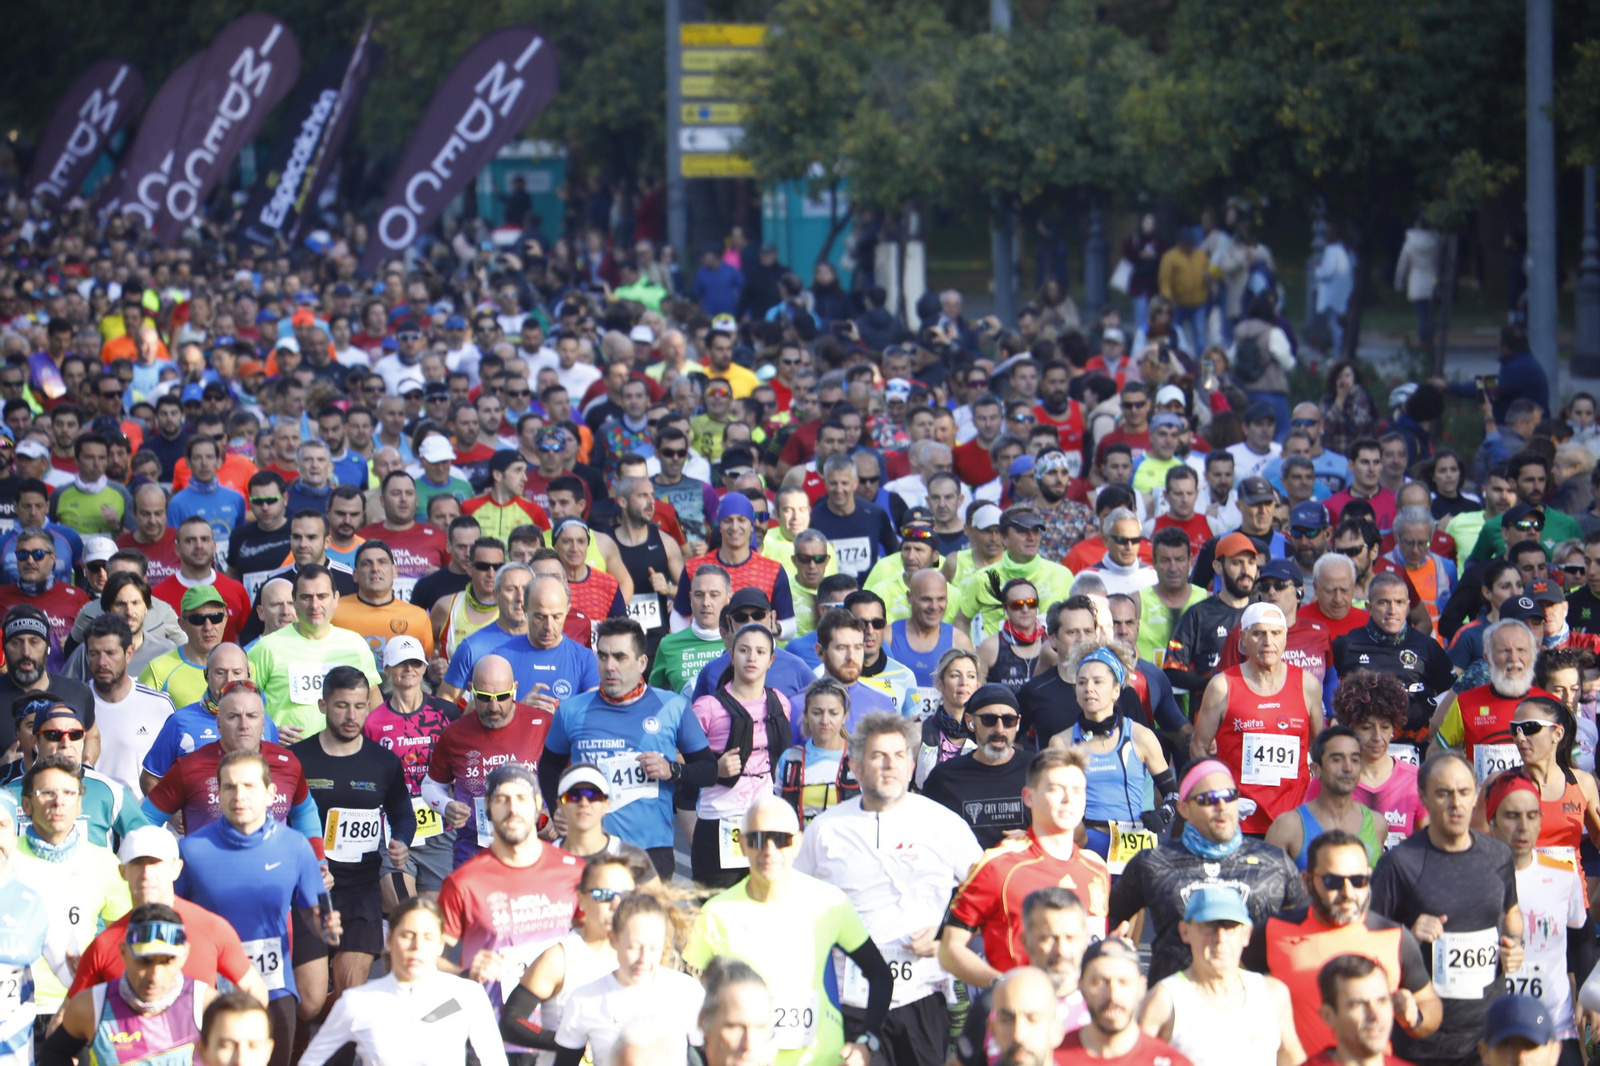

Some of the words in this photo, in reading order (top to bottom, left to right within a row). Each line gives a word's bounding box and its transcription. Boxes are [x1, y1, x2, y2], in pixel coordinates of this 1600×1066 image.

[166, 23, 283, 221] IMDECO
[378, 36, 544, 250] IMDECO
[836, 547, 868, 561] 1774
[682, 652, 694, 661] En
[682, 669, 690, 677] el
[301, 675, 325, 691] 36
[1239, 719, 1264, 729] califas
[577, 739, 626, 750] ATLETISMO
[483, 753, 518, 767] MEDIA
[1254, 746, 1294, 764] 4191
[465, 767, 480, 778] 36
[1487, 759, 1523, 775] 291
[415, 808, 437, 825] 31
[339, 820, 379, 838] 1880
[1120, 832, 1154, 851] 1971
[510, 893, 551, 912] MEDIA
[68, 906, 80, 925] 6
[491, 909, 511, 926] 36
[512, 899, 573, 925] MARATÓN
[248, 952, 279, 973] 13
[1449, 946, 1497, 969] 2662
[0, 979, 18, 998] 2
[1505, 978, 1543, 998] 976
[774, 1007, 813, 1029] 230
